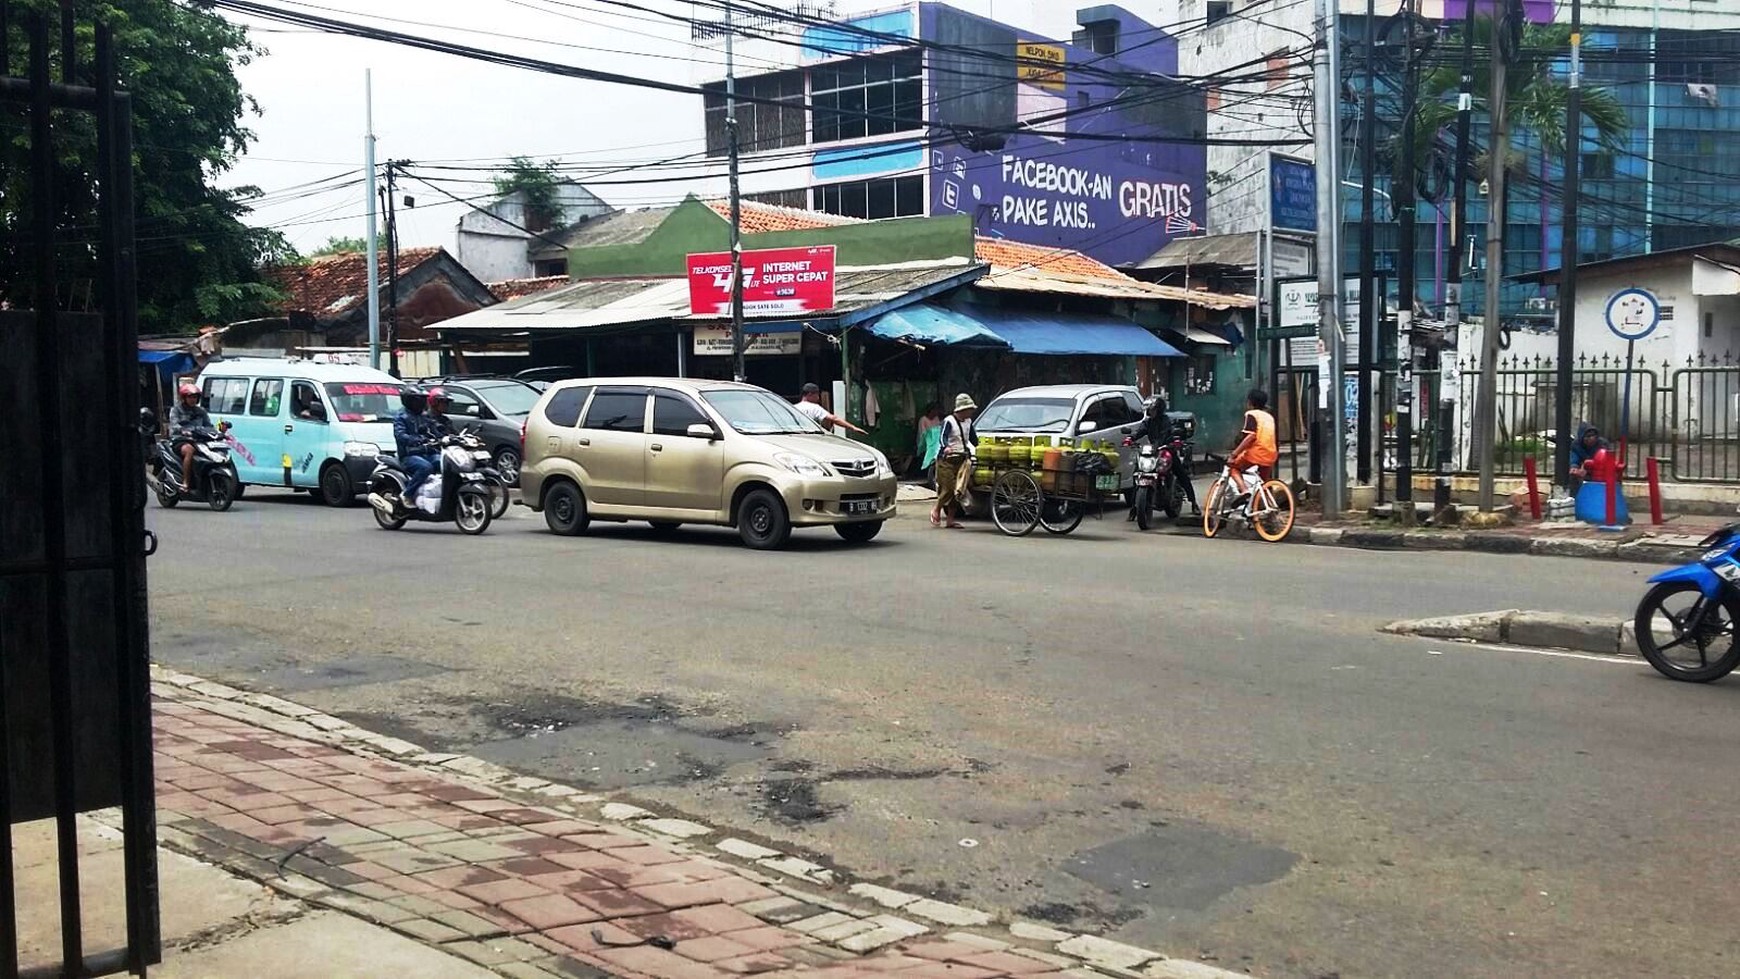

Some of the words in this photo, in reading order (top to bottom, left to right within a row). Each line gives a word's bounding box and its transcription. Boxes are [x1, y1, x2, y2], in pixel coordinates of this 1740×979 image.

[1002, 155, 1112, 200] FACEBOOK-AN
[1003, 195, 1047, 226] PAKE
[1053, 200, 1096, 229] AXIS..
[1119, 181, 1191, 219] GRATIS
[763, 261, 811, 273] INTERNET
[763, 273, 795, 285] SUPER
[796, 271, 828, 283] CEPAT
